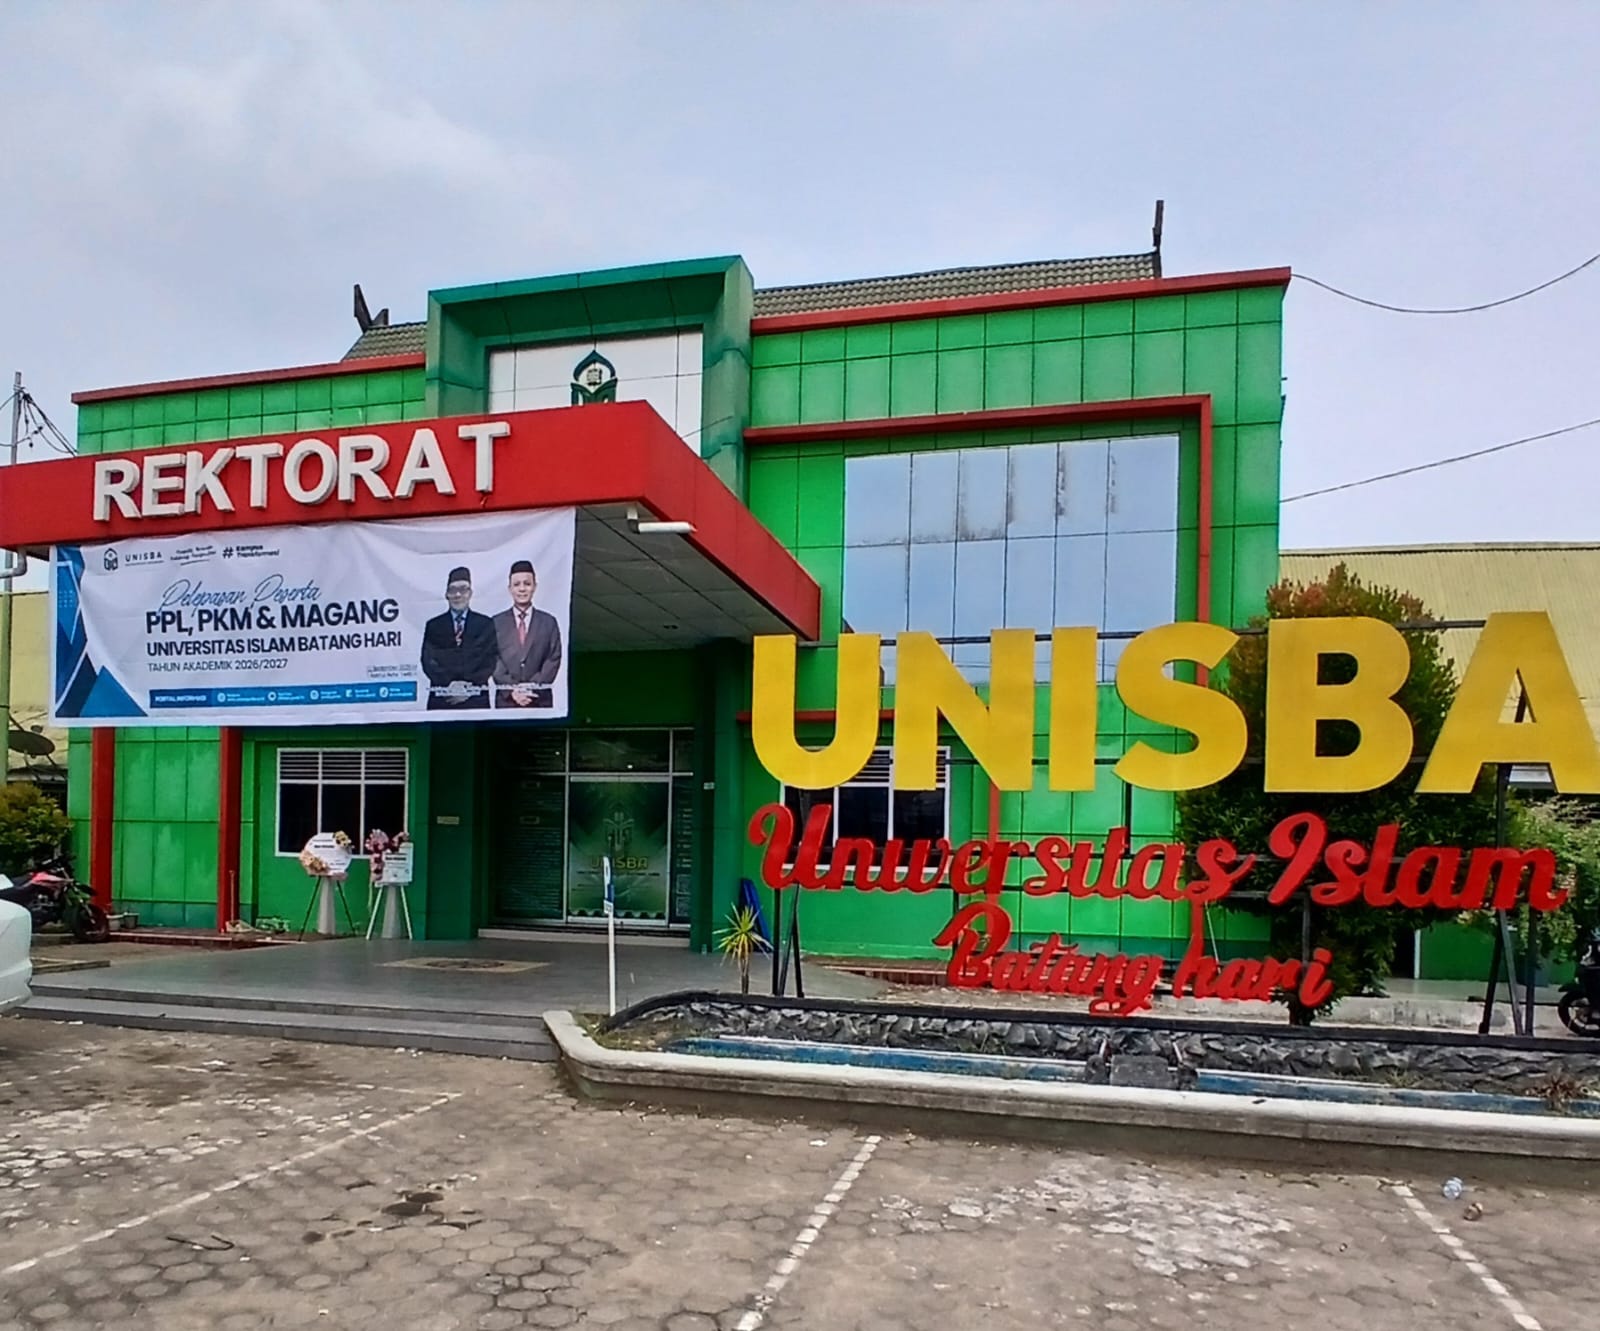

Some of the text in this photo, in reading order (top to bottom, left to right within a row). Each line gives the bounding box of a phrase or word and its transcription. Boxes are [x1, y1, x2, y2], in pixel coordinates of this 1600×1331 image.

[93, 421, 510, 520] REKTORAT
[125, 551, 162, 562] UNISBA
[159, 574, 322, 617] Pelepasan Peserta
[146, 599, 399, 636] PPL, PKM & MAGANG
[147, 630, 402, 657] UNIVERSITAS ISLAM BATANG HARI
[148, 658, 288, 672] TAHUN AKADEMIK 2026/2027
[752, 611, 1600, 794] UNISBA
[590, 856, 648, 869] UISBA
[1268, 811, 1569, 911] Islam
[932, 898, 1335, 1017] Batang hari
